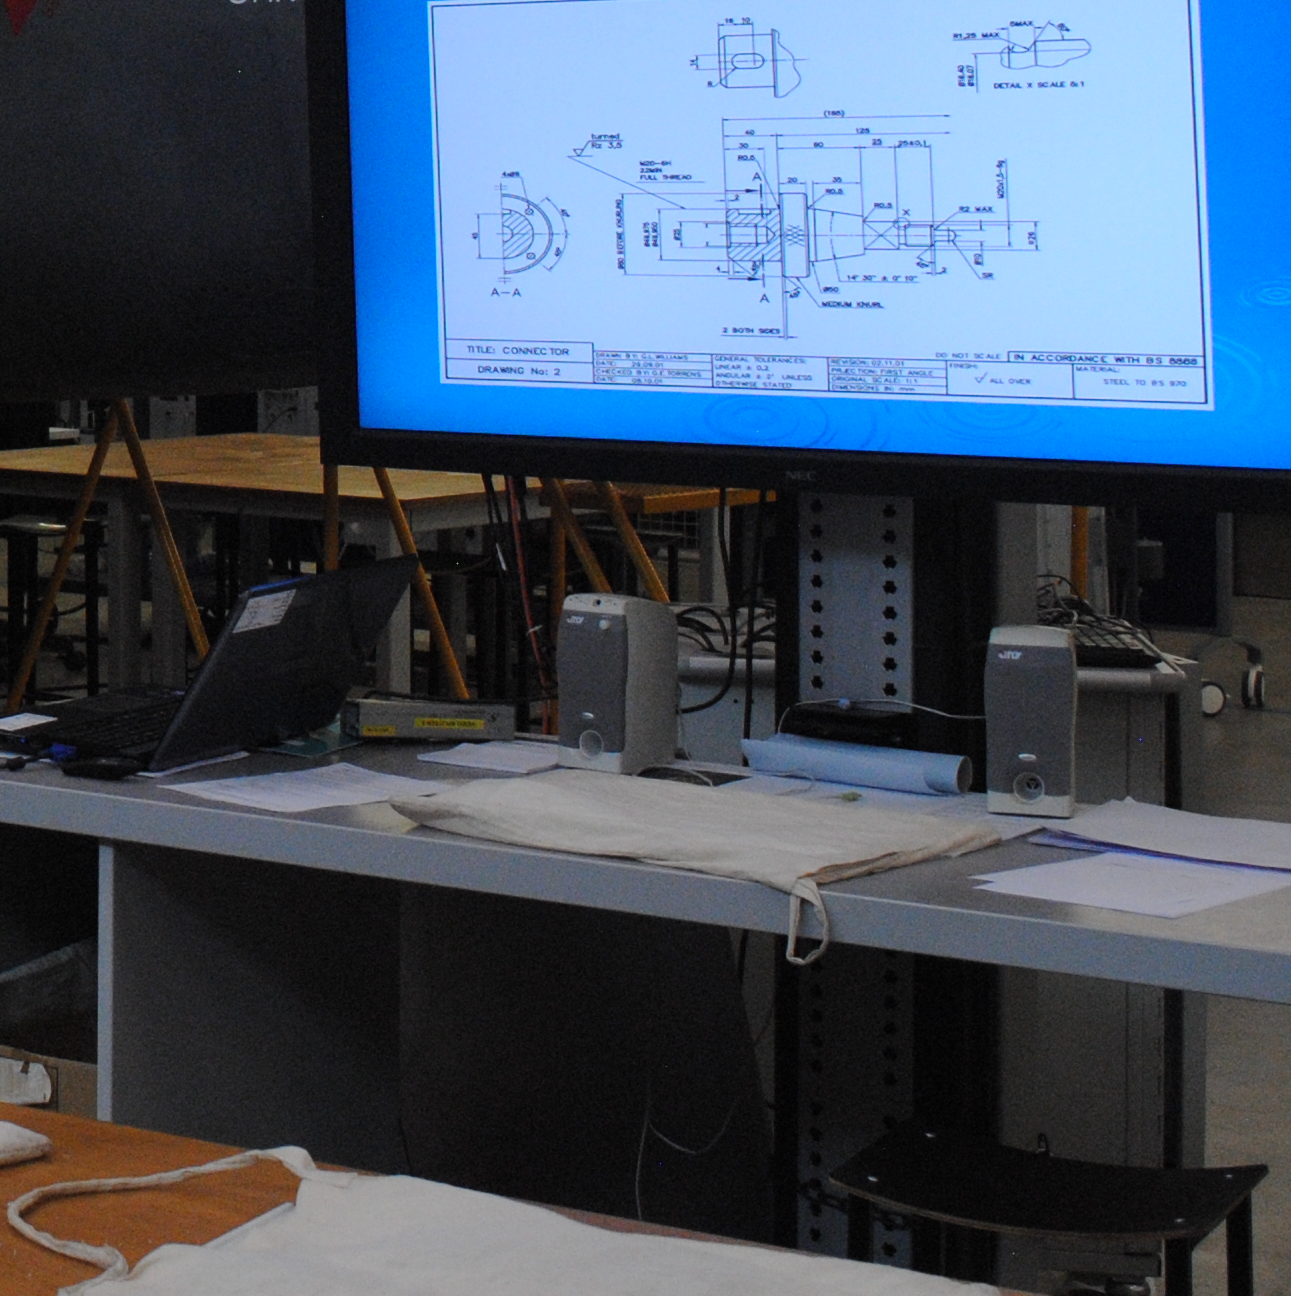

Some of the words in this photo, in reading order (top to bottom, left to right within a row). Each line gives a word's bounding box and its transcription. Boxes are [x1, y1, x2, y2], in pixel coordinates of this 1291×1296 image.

[752, 172, 762, 181] A
[760, 293, 770, 303] A
[467, 344, 496, 354] TITLE:
[503, 345, 570, 356] CONNECTOR
[1013, 354, 1024, 362] IN
[1031, 354, 1108, 363] ACCORDANCE
[1114, 355, 1140, 364] WITH
[1146, 356, 1162, 364] BS
[477, 364, 524, 375] DRAWING
[531, 366, 549, 376] No:
[553, 367, 561, 377] 2
[880, 368, 903, 376] FIRST
[1103, 378, 1131, 386] STEEL
[785, 470, 817, 482] NEC
